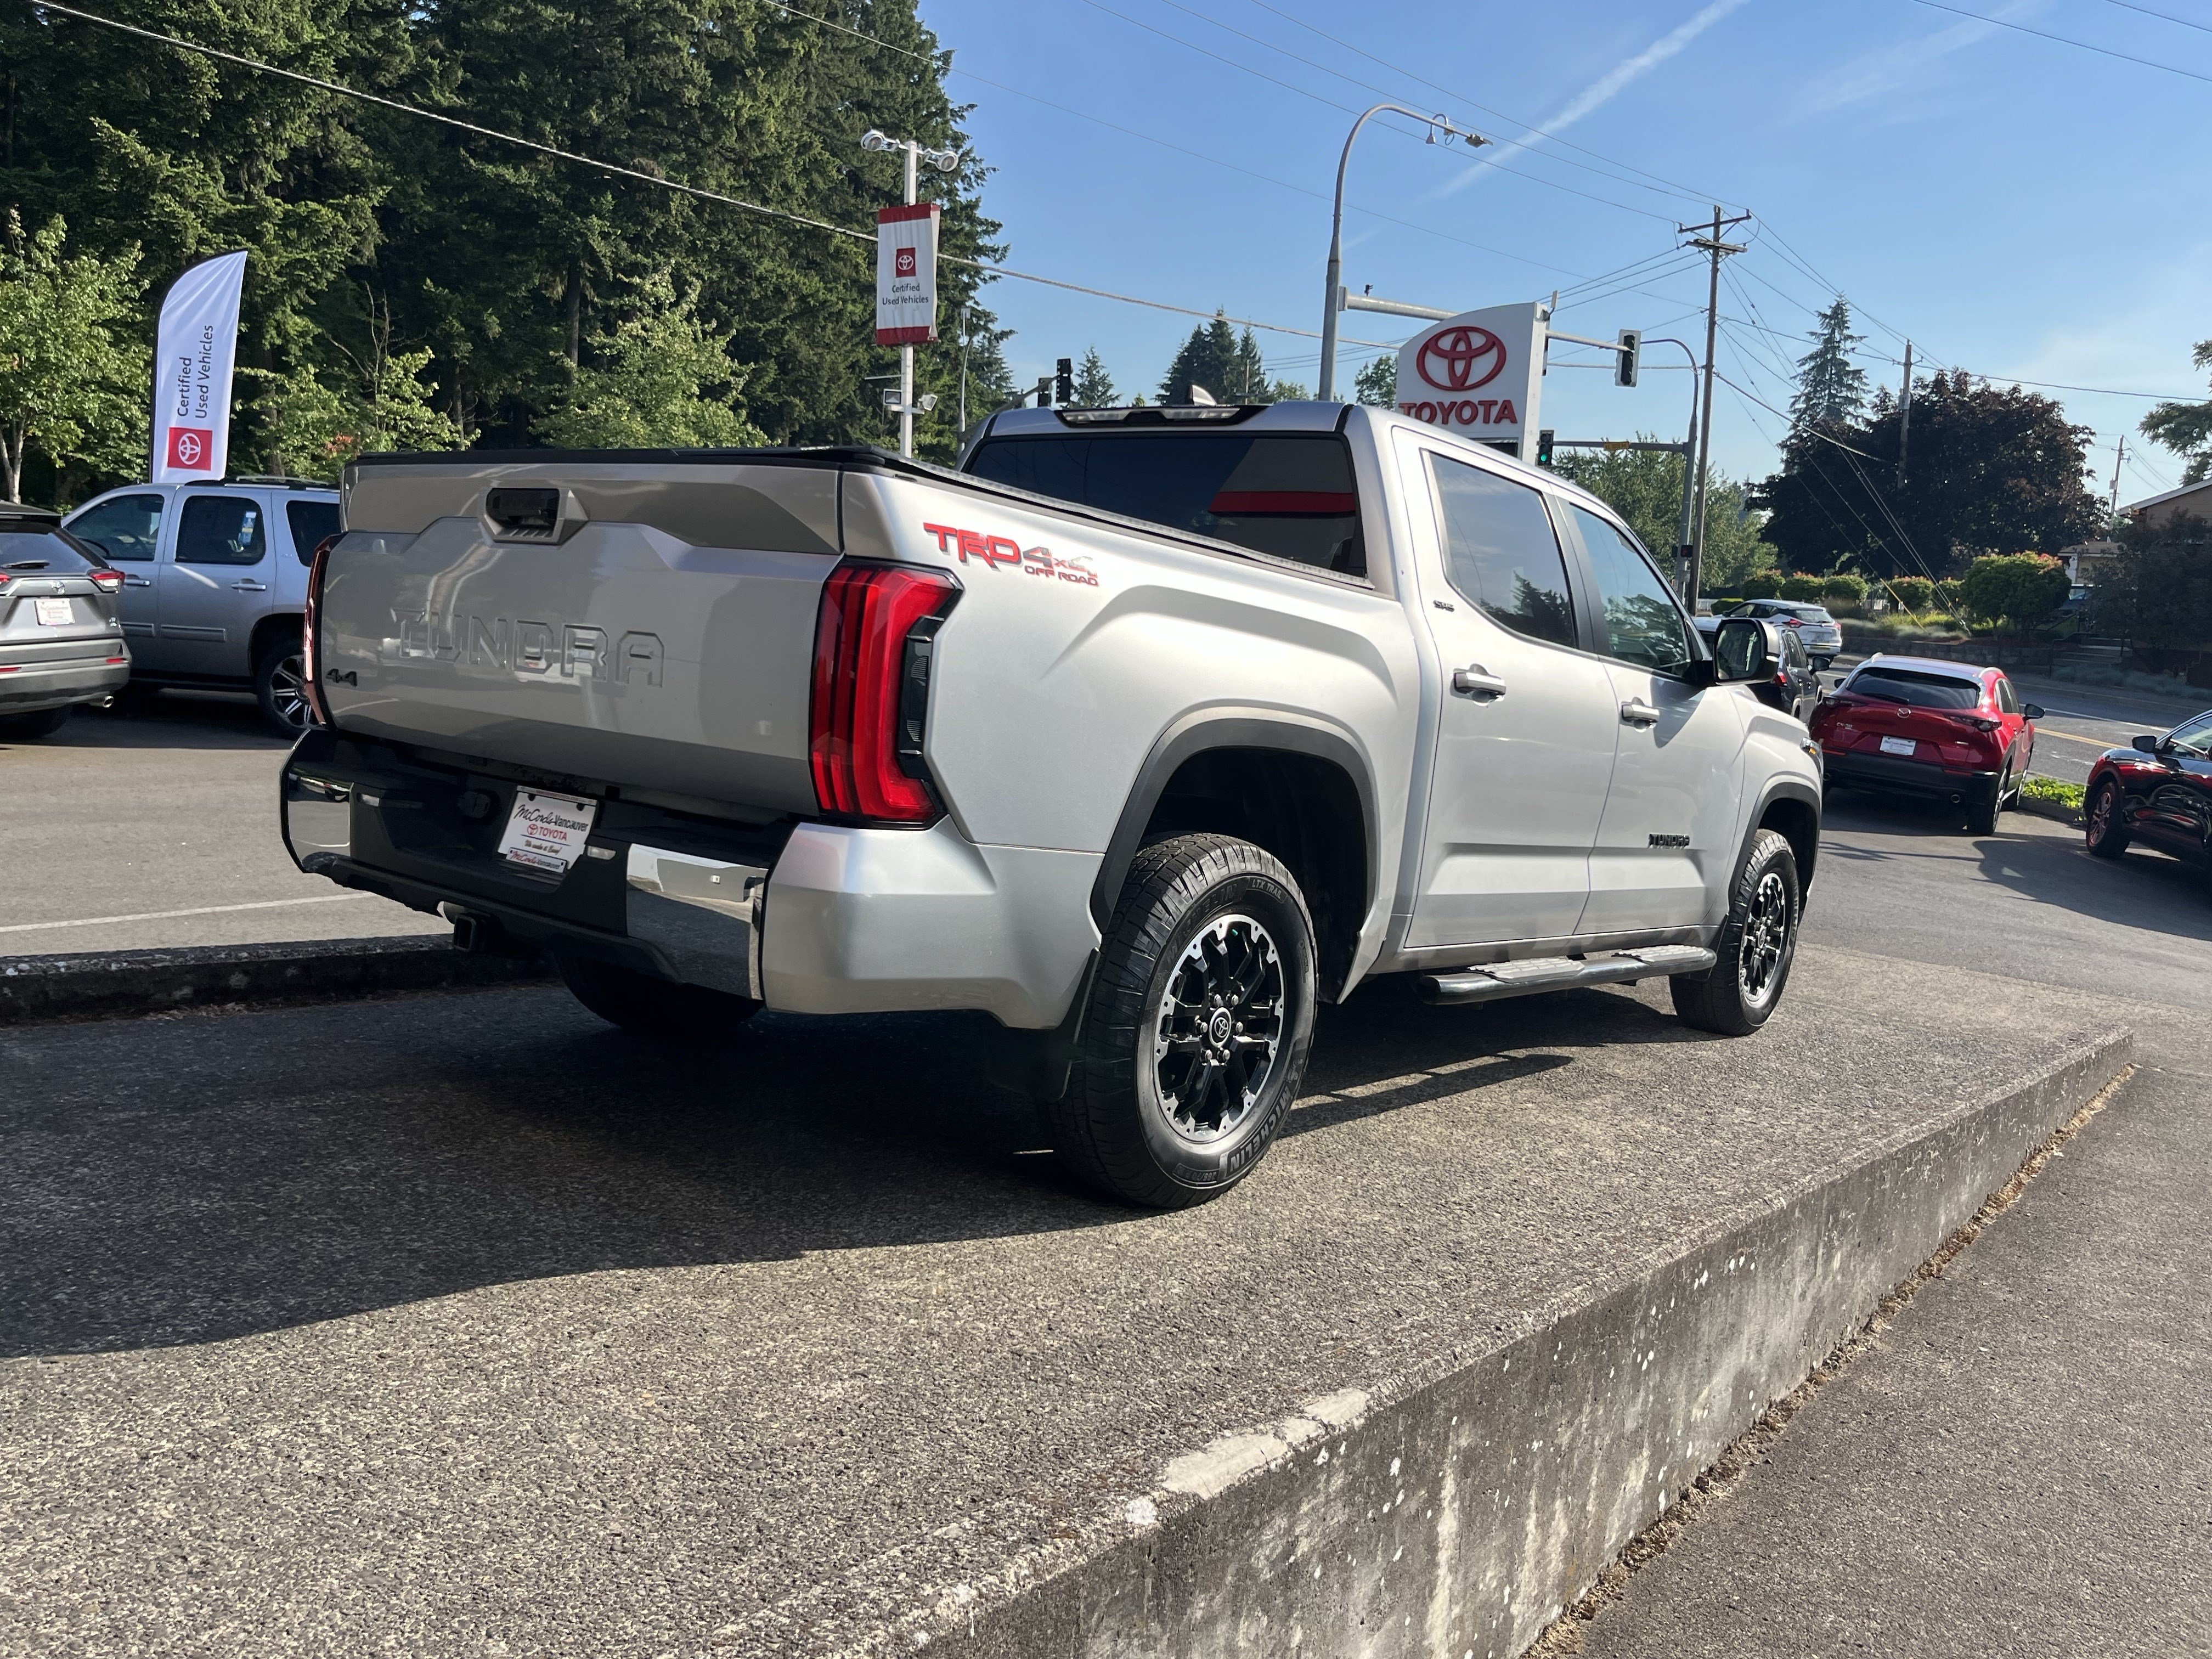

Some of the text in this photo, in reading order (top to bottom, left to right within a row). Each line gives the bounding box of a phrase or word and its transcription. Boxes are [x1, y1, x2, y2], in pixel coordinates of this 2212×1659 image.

[882, 295, 929, 305] Used Vehicles
[892, 283, 920, 293] Certified
[195, 325, 213, 419] Used Vehicles
[177, 357, 192, 416] Certified
[1398, 399, 1517, 425] TOYOTA
[923, 522, 1022, 571] TRD
[1024, 565, 1099, 587] OFF ROAD
[391, 607, 664, 688] TUNDRA
[539, 827, 567, 842] TOYOTA
[1252, 879, 1282, 899] LTX TRAIL
[1229, 1086, 1293, 1172] MICHELIN
